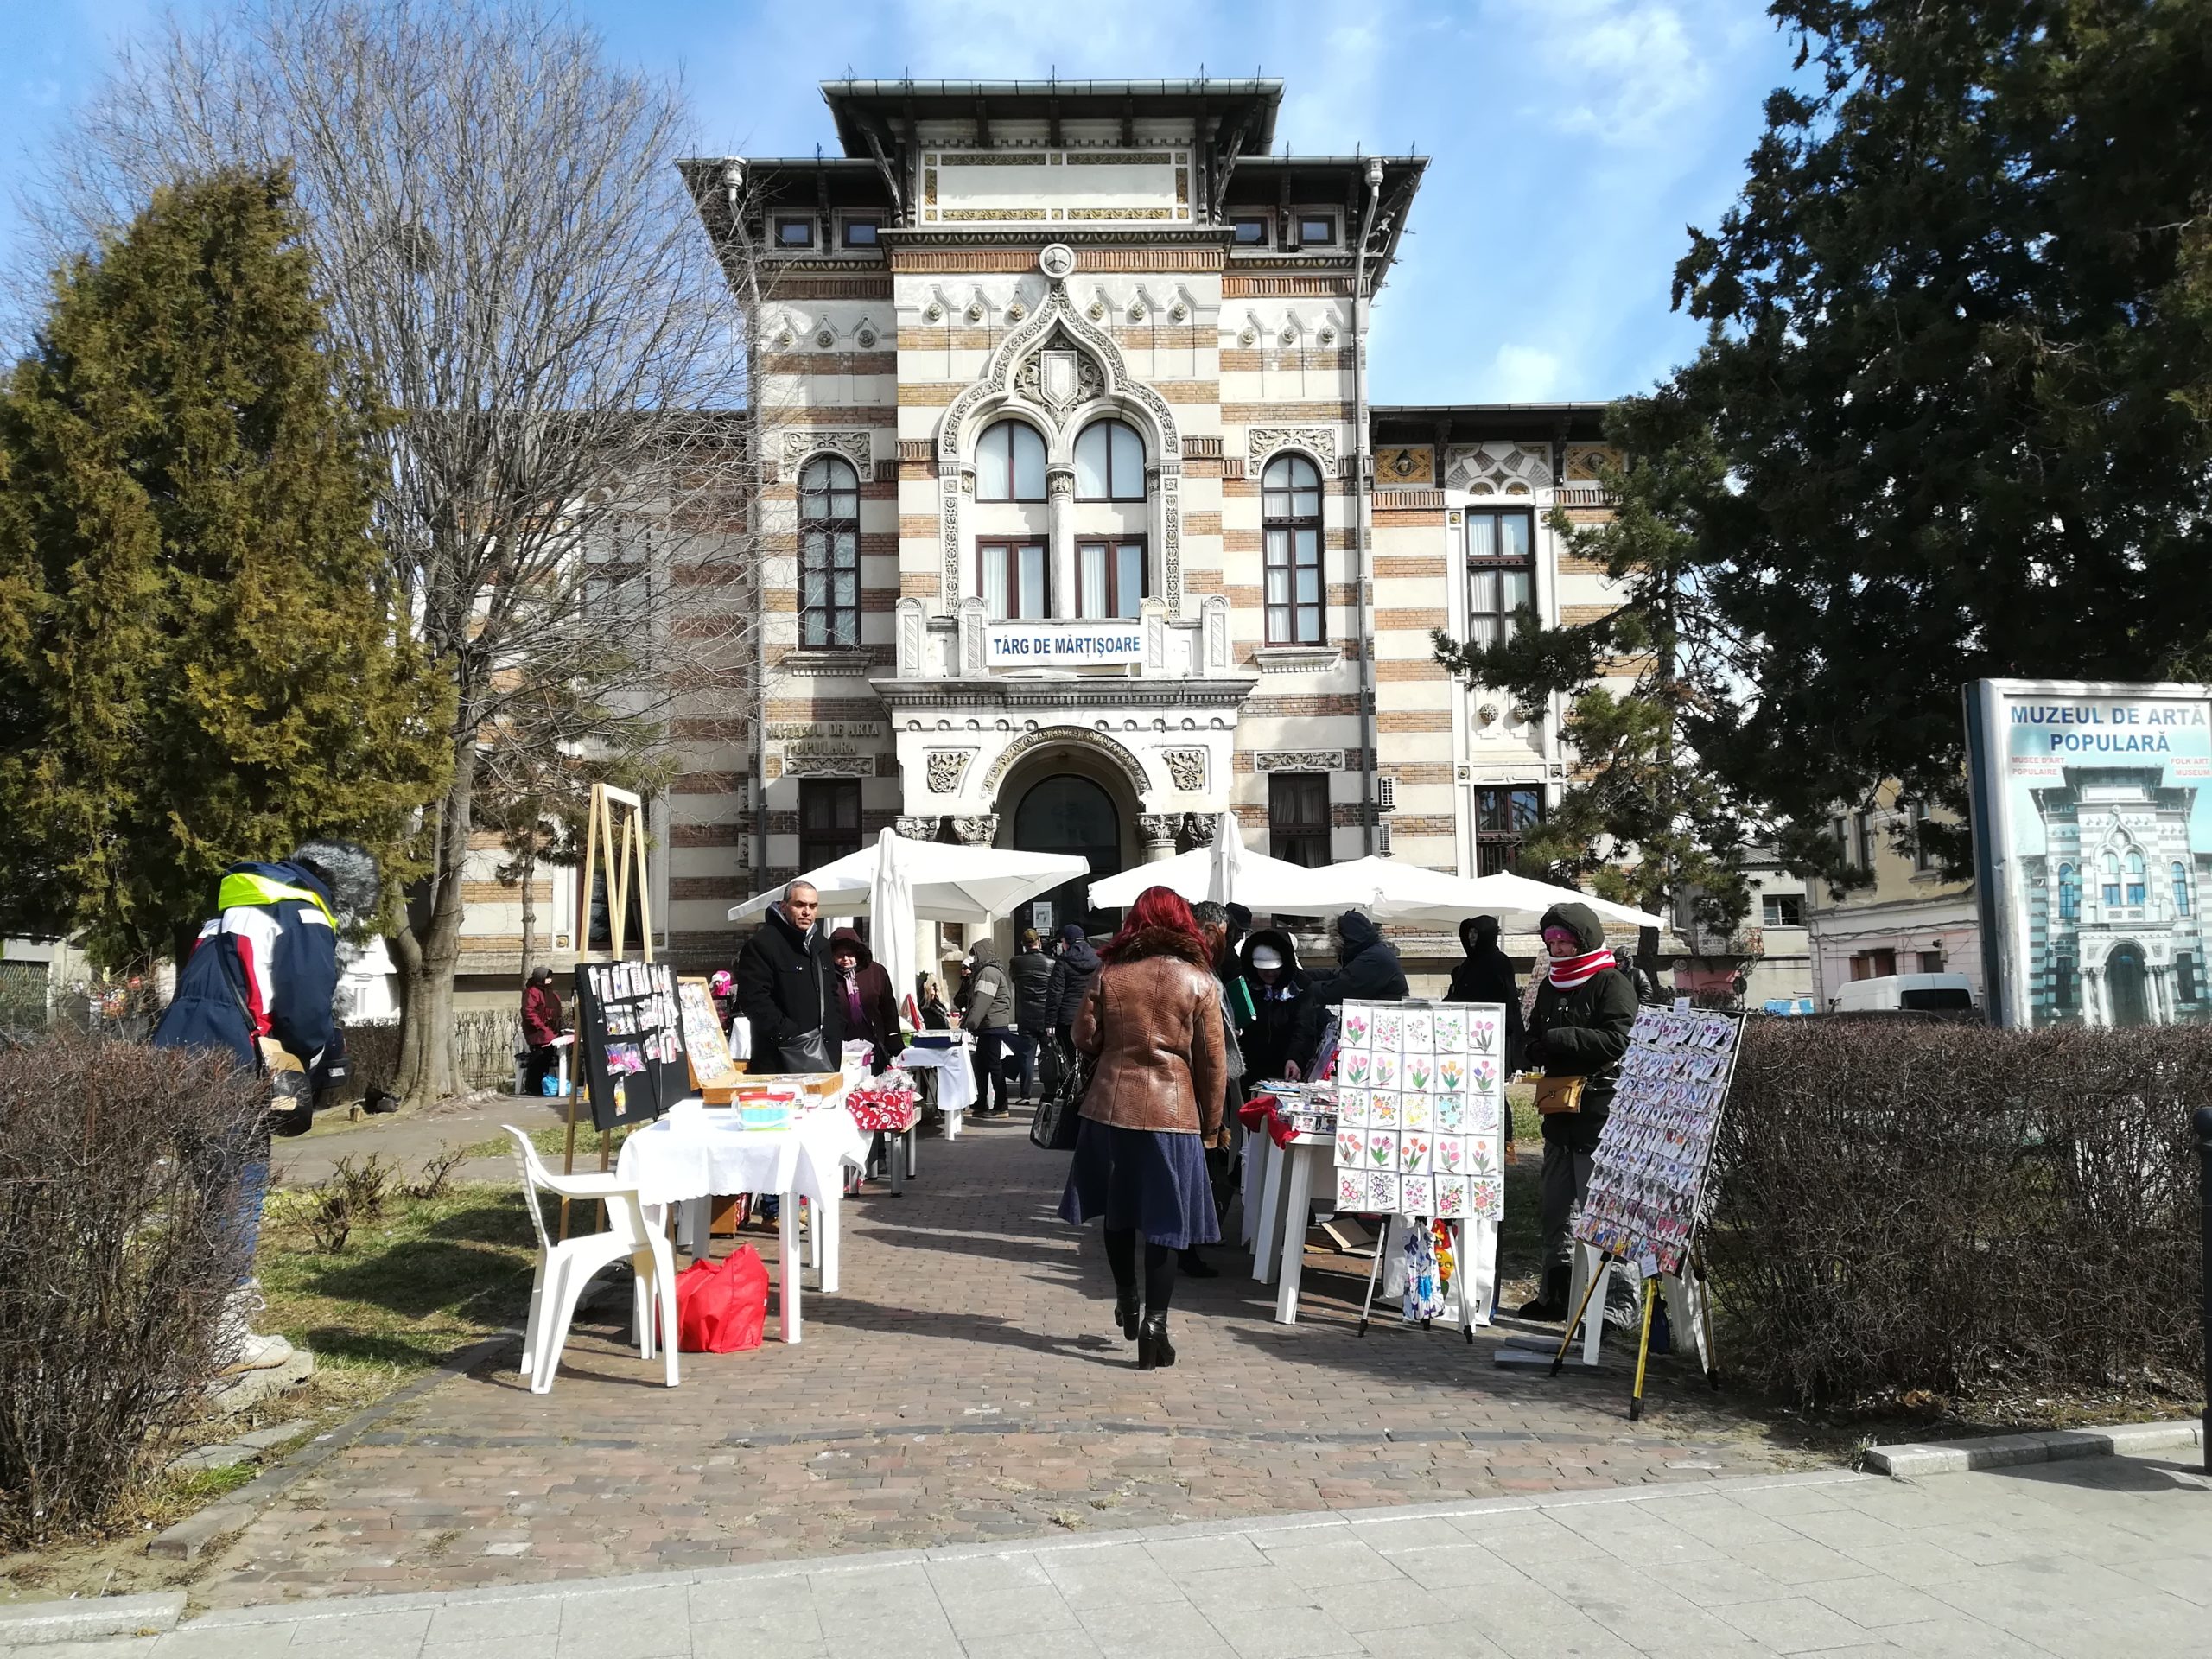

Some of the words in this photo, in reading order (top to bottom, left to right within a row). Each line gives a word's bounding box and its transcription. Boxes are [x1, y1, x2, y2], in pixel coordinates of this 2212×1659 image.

[994, 635, 1029, 655] TÂRG
[1033, 638, 1051, 654] DE
[2011, 706, 2104, 724] MUZEUL
[2112, 707, 2139, 725] DE
[2147, 703, 2206, 726] ARTĂ
[830, 722, 845, 736] DE
[2050, 730, 2171, 753] POPULARĂ
